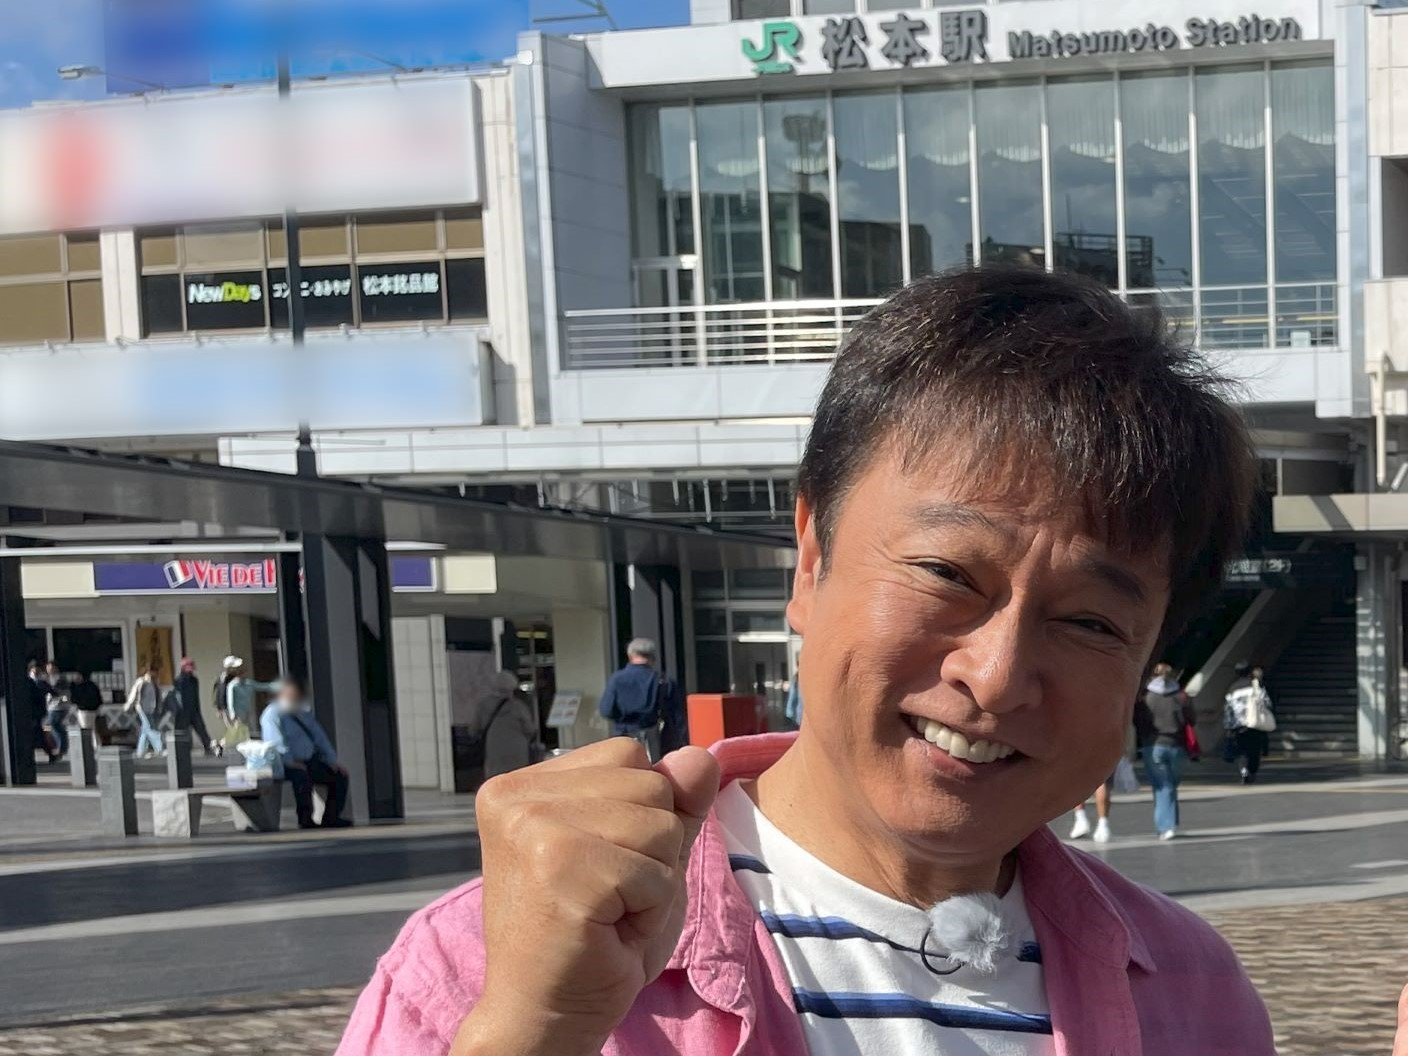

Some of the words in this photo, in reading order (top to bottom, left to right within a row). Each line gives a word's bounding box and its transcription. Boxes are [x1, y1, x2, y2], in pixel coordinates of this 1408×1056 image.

[742, 22, 801, 62] JR
[822, 9, 989, 72] 松本駅
[1007, 23, 1181, 58] Matsumoto
[1186, 13, 1304, 47] Station
[189, 281, 262, 303] NewDays
[191, 559, 229, 590] VIE
[231, 563, 263, 588] DE
